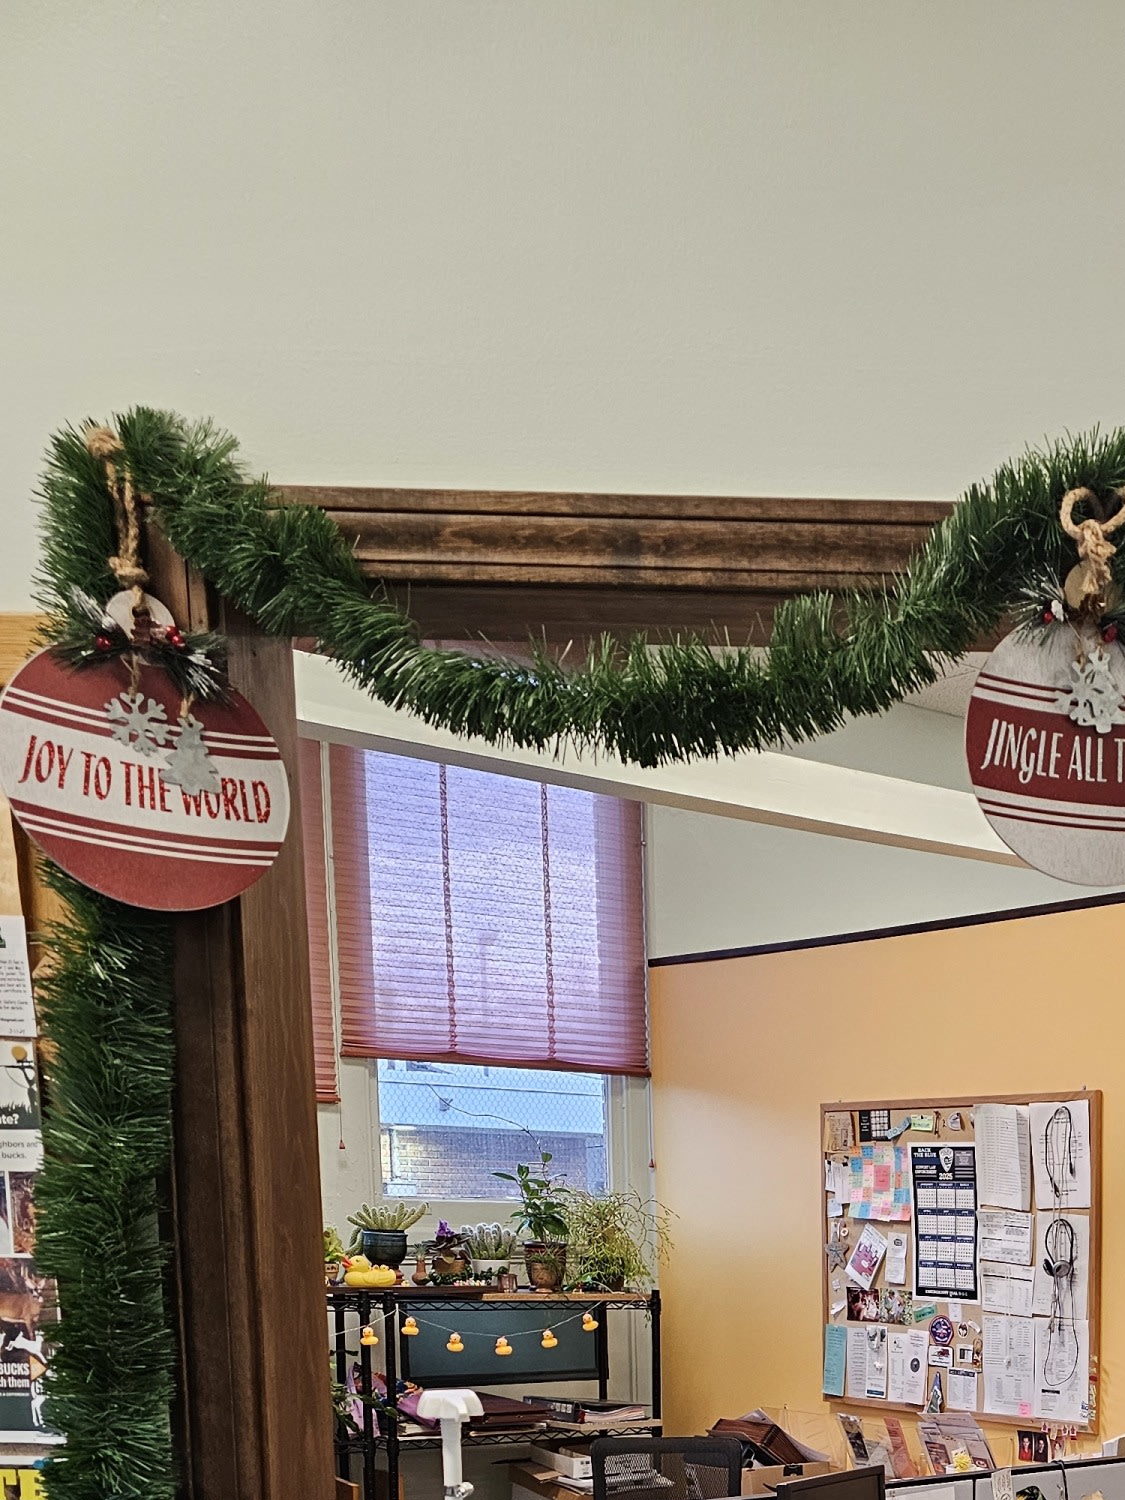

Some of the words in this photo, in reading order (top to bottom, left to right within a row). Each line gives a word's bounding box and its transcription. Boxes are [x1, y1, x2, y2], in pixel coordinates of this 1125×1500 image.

[18, 734, 74, 789] JOY
[80, 751, 112, 800] TO
[120, 761, 173, 813] THE
[980, 718, 1063, 784] JINGLE
[1068, 735, 1107, 783] ALL
